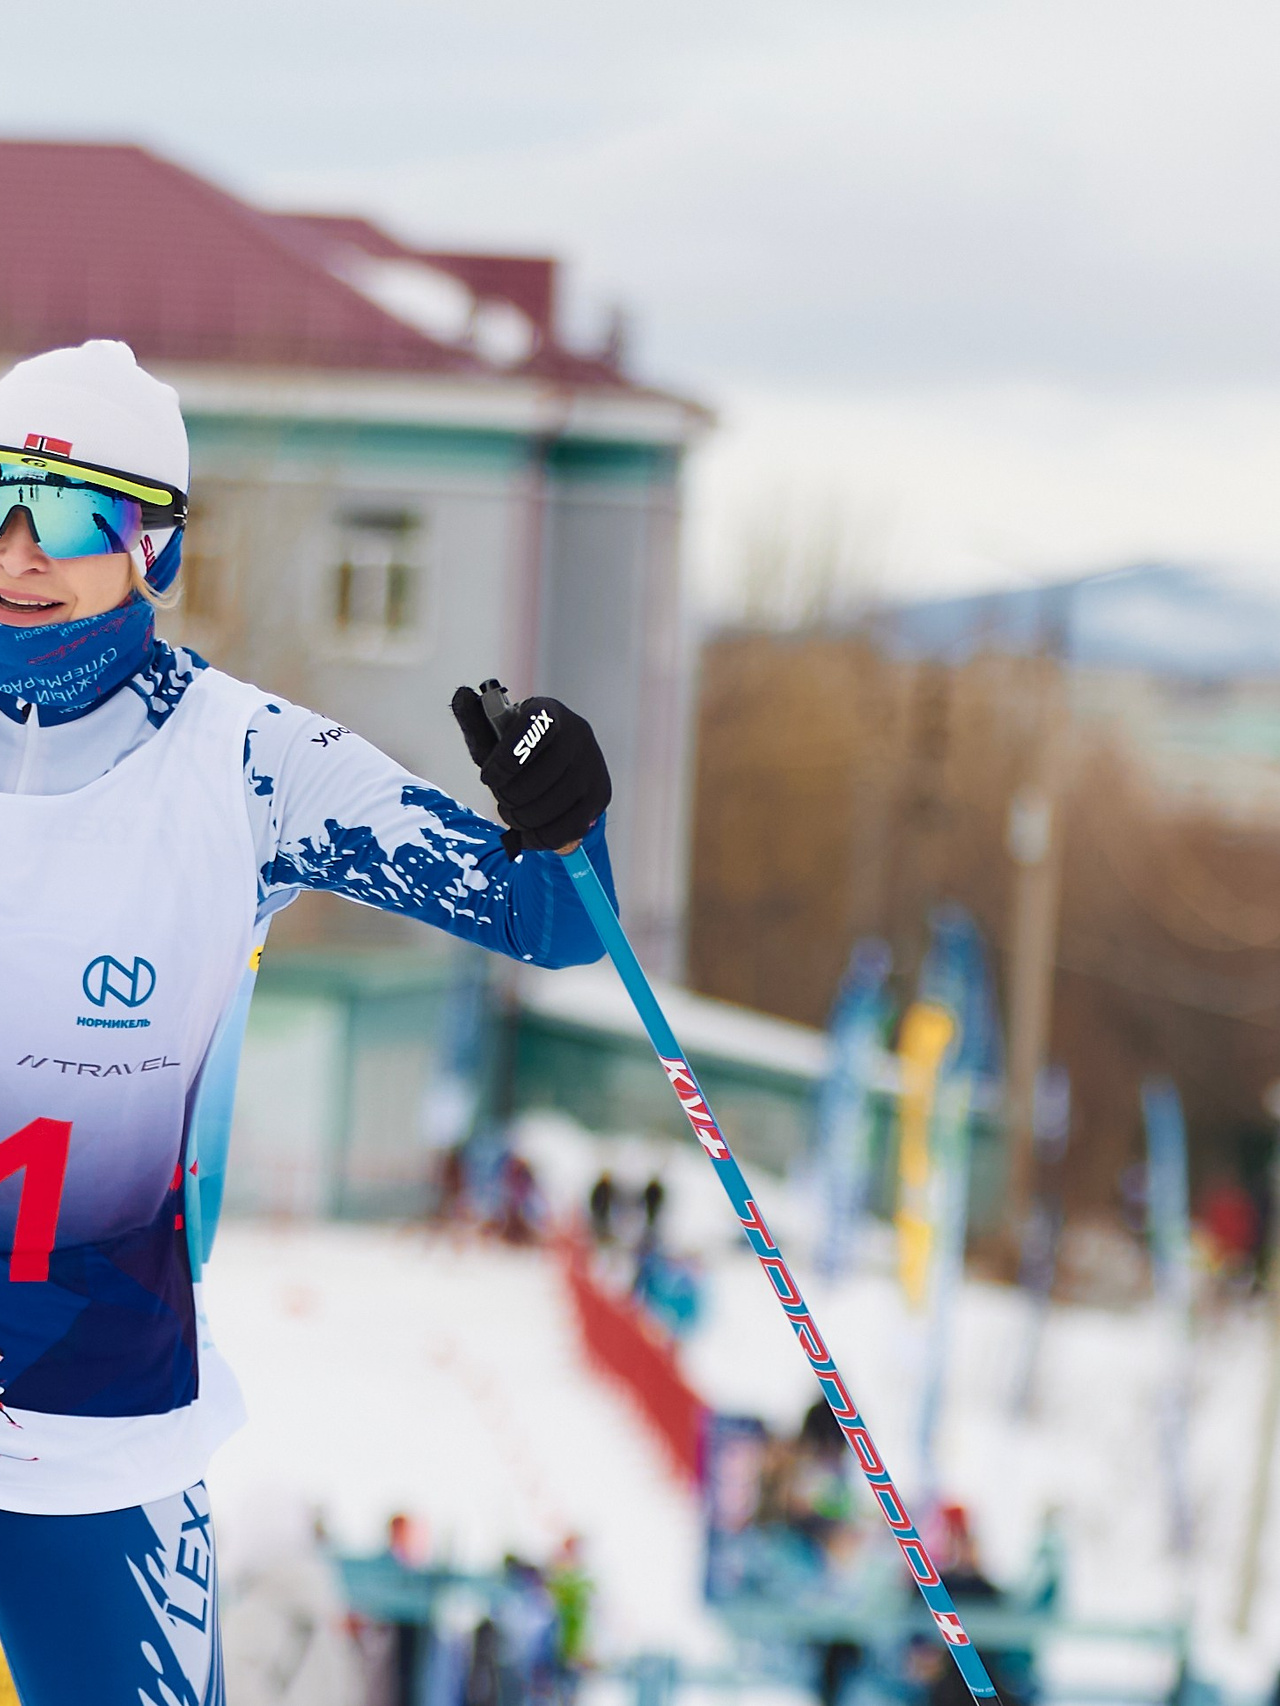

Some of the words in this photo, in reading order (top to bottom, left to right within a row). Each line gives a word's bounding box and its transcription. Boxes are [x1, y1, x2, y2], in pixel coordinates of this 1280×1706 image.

[76, 1016, 151, 1029] НОРНИКЕЛЬ
[53, 1055, 181, 1078] TRAVEL
[740, 1200, 940, 1586] TORNADO
